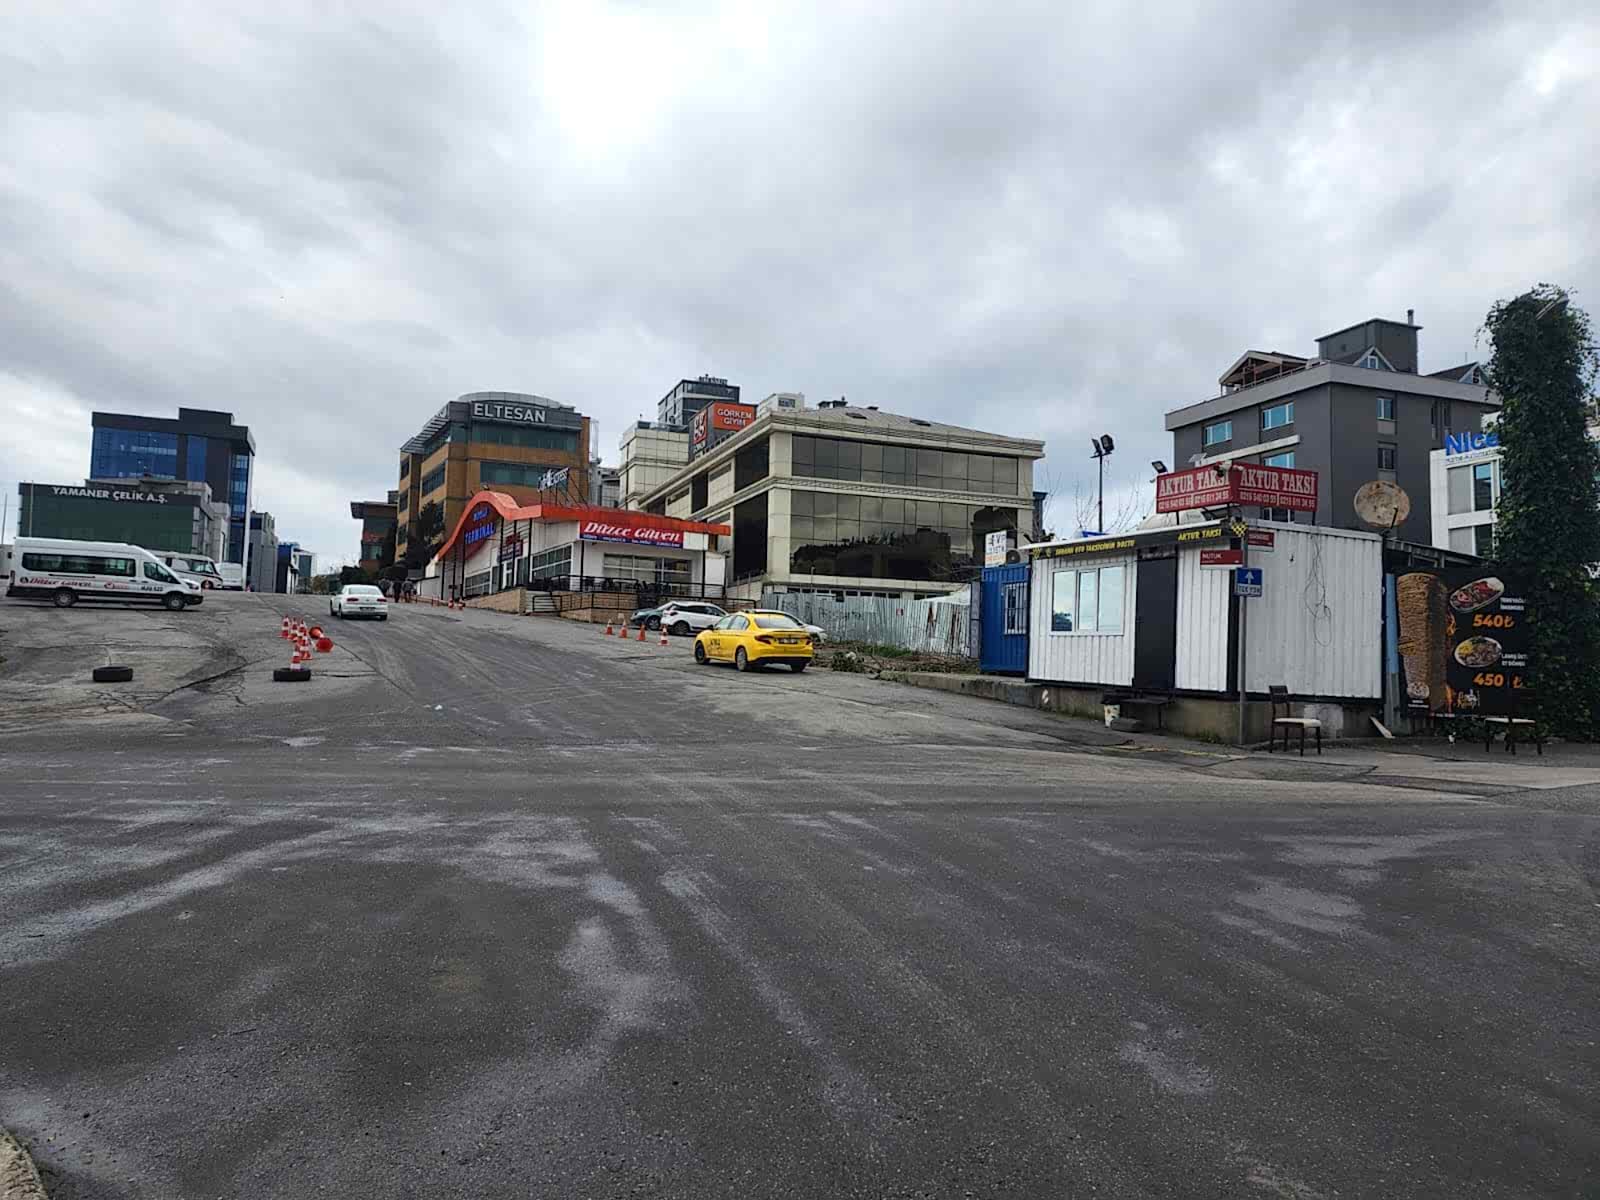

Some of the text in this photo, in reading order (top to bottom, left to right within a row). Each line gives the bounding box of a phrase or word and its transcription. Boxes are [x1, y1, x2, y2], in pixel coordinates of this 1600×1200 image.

[473, 402, 546, 423] ELTESAN
[1159, 473, 1194, 497] AKTUR
[1240, 468, 1315, 495] AKTUR TAKSİ
[51, 486, 168, 504] YAMANER ÇELİK A.Ş.
[634, 527, 680, 543] Güven
[1178, 530, 1200, 541] AKTUR
[1473, 673, 1504, 687] 450
